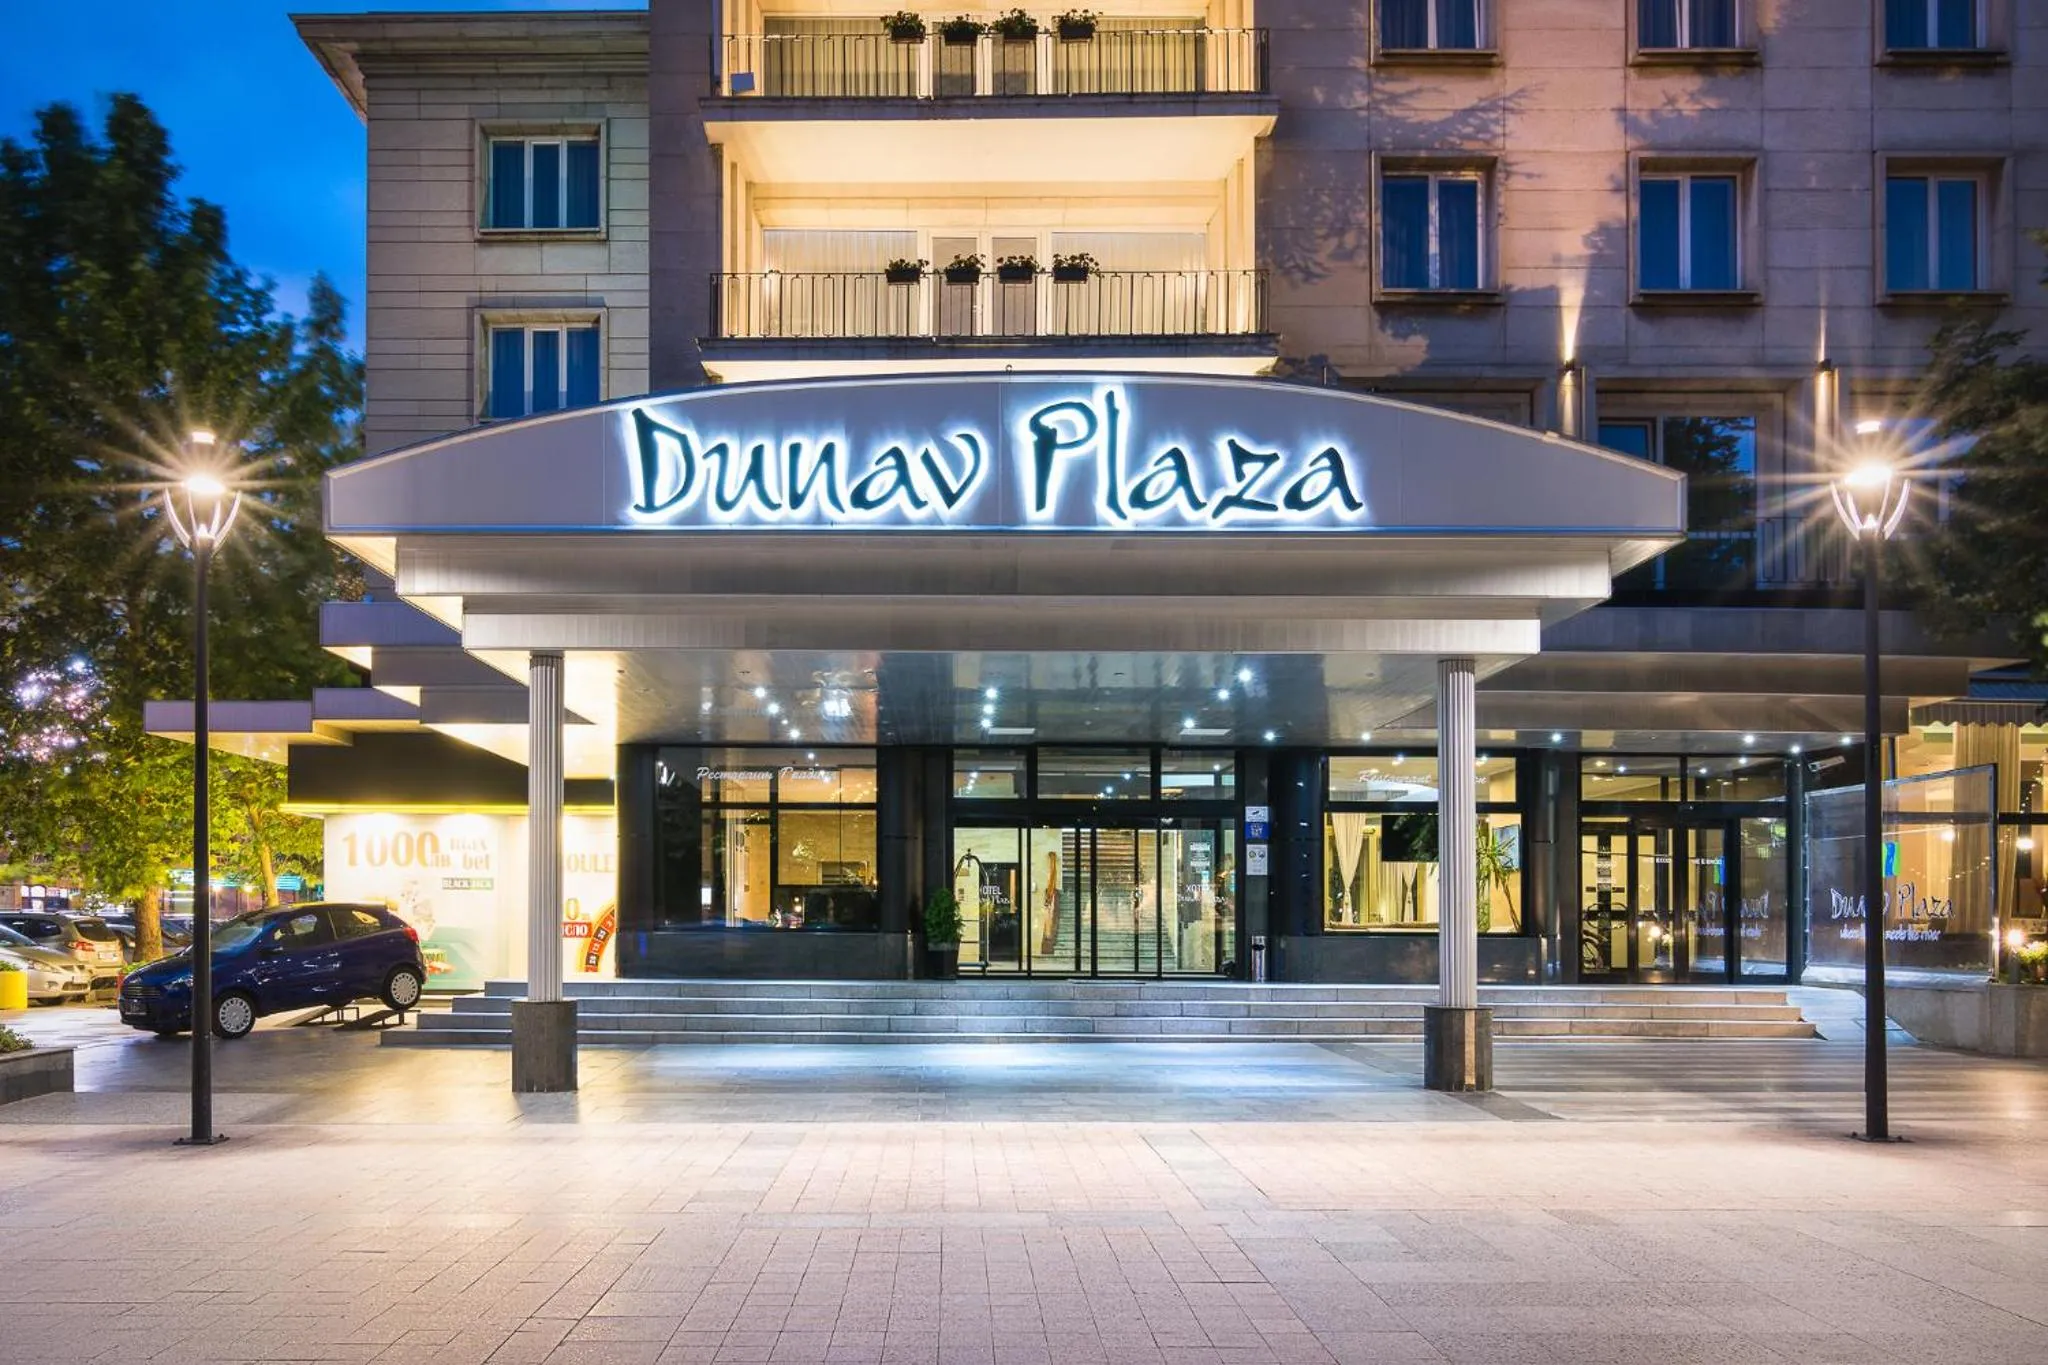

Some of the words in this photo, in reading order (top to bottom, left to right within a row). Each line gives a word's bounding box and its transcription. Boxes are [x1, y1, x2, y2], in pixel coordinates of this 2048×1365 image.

[630, 405, 986, 516] Dunav
[1028, 388, 1364, 522] Plaza
[341, 830, 440, 868] 1000
[463, 852, 490, 871] bet
[980, 885, 1003, 895] OTEL
